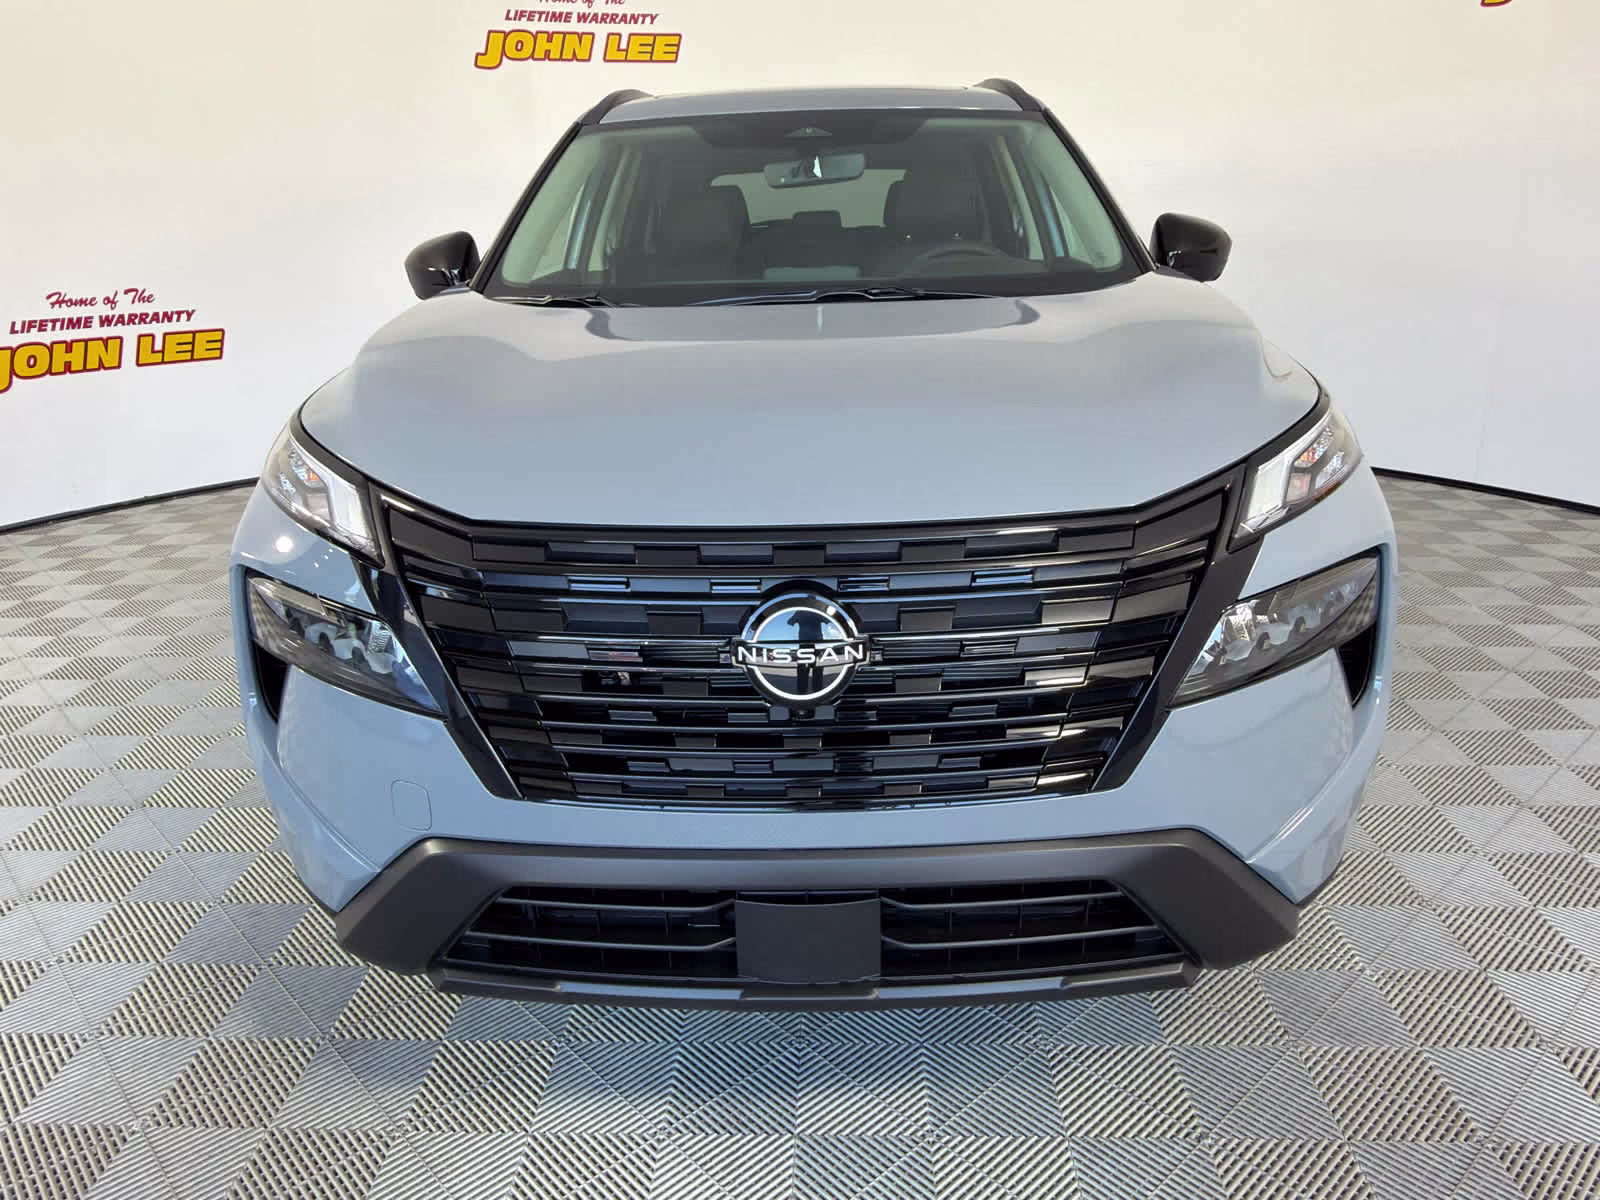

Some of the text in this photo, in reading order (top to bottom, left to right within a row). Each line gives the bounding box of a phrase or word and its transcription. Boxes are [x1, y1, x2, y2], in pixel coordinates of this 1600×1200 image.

[504, 9, 659, 25] LIFETIME WARRANTY
[474, 29, 682, 70] JOHN LEE
[46, 287, 155, 310] Home of The
[9, 309, 196, 335] LIFETIME WARRANTY
[136, 328, 225, 367] LEE
[737, 644, 864, 664] NISSAN
